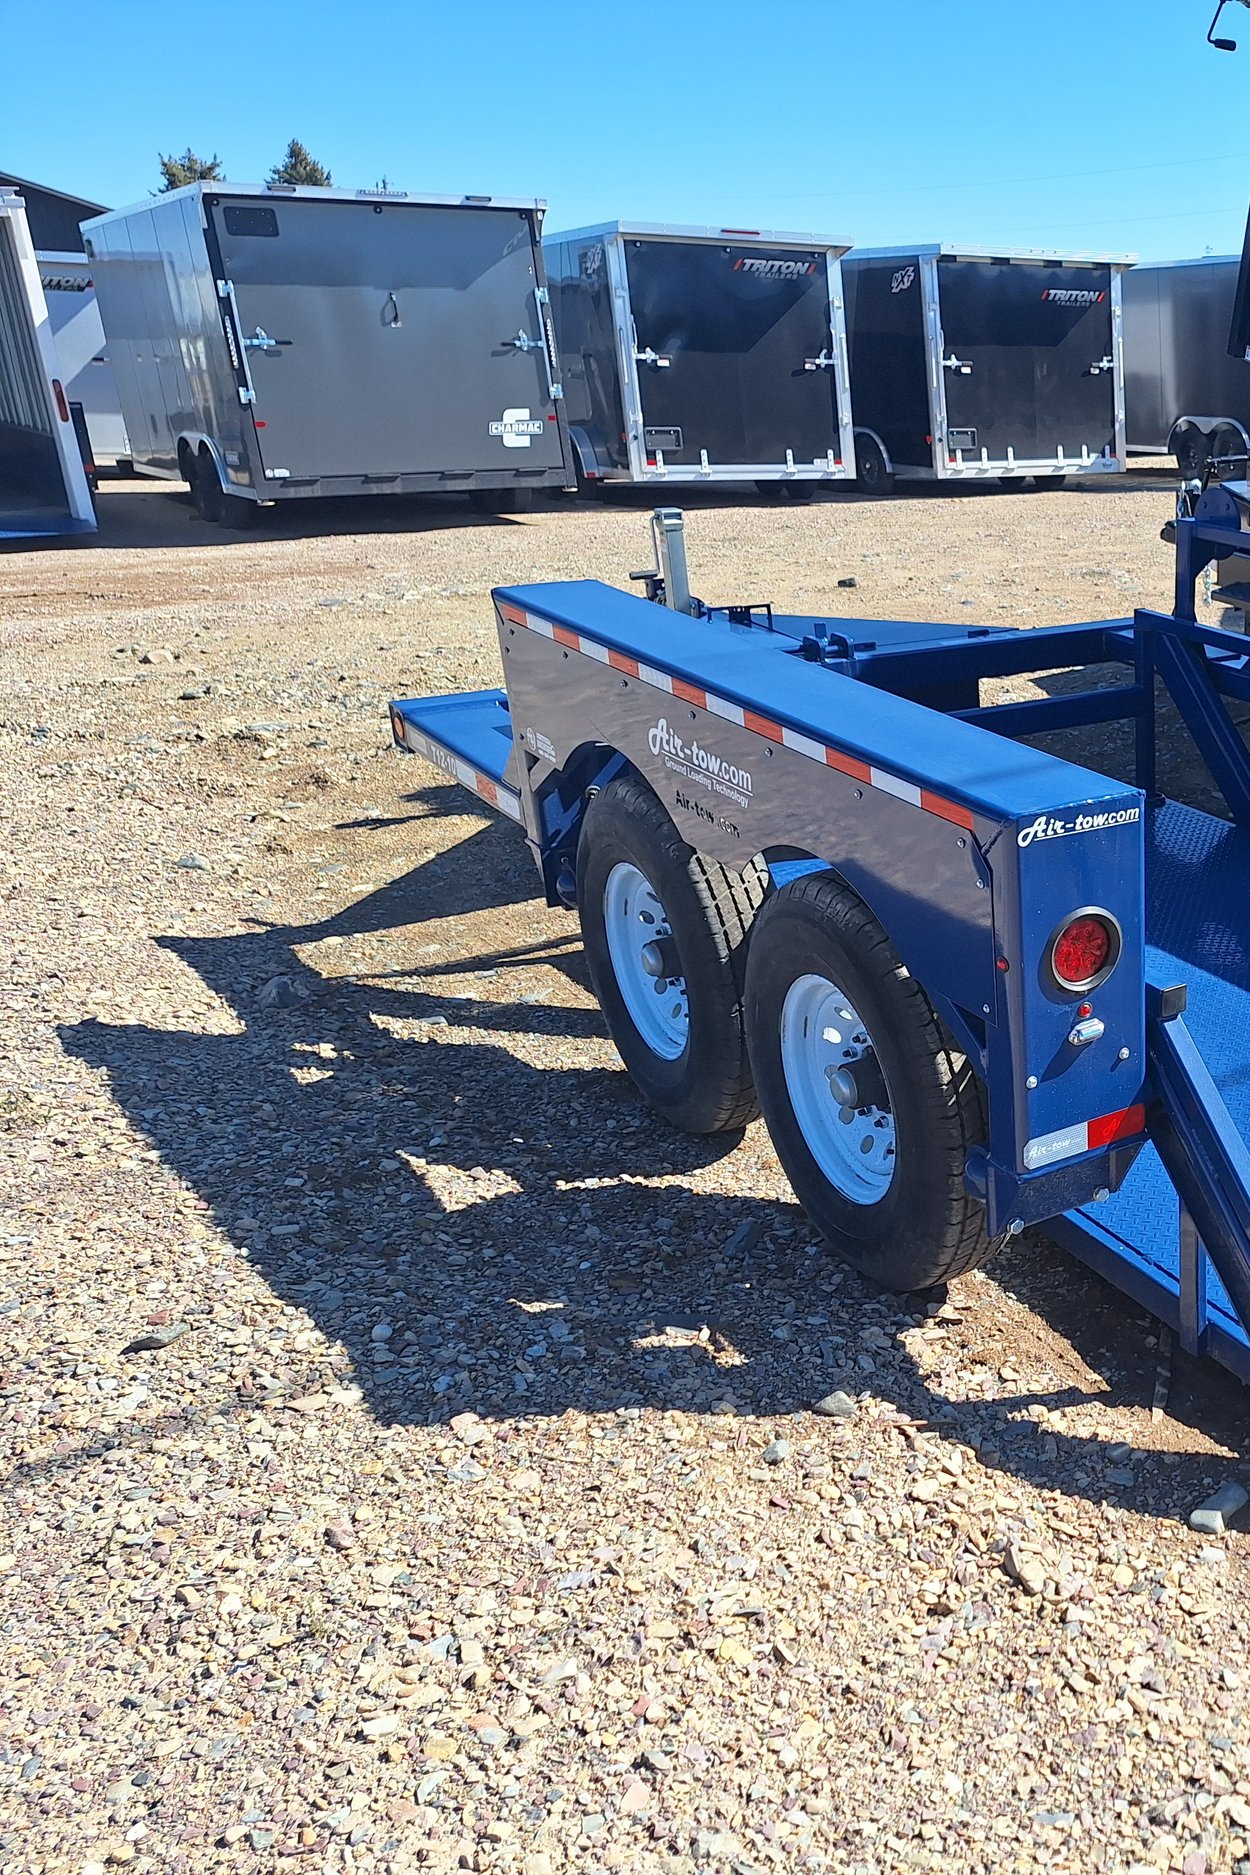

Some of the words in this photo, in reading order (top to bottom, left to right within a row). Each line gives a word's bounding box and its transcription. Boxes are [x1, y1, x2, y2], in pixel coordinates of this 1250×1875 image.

[743, 259, 810, 275] TRITON
[755, 272, 798, 280] TRAILERS
[1048, 289, 1100, 302] TRITON
[491, 423, 541, 434] CHARMAC
[648, 718, 752, 792] Air-tow.com
[664, 756, 687, 777] Ground
[687, 766, 713, 791] Loading
[712, 779, 749, 809] Technology
[1017, 807, 1140, 848] Air-tow.com
